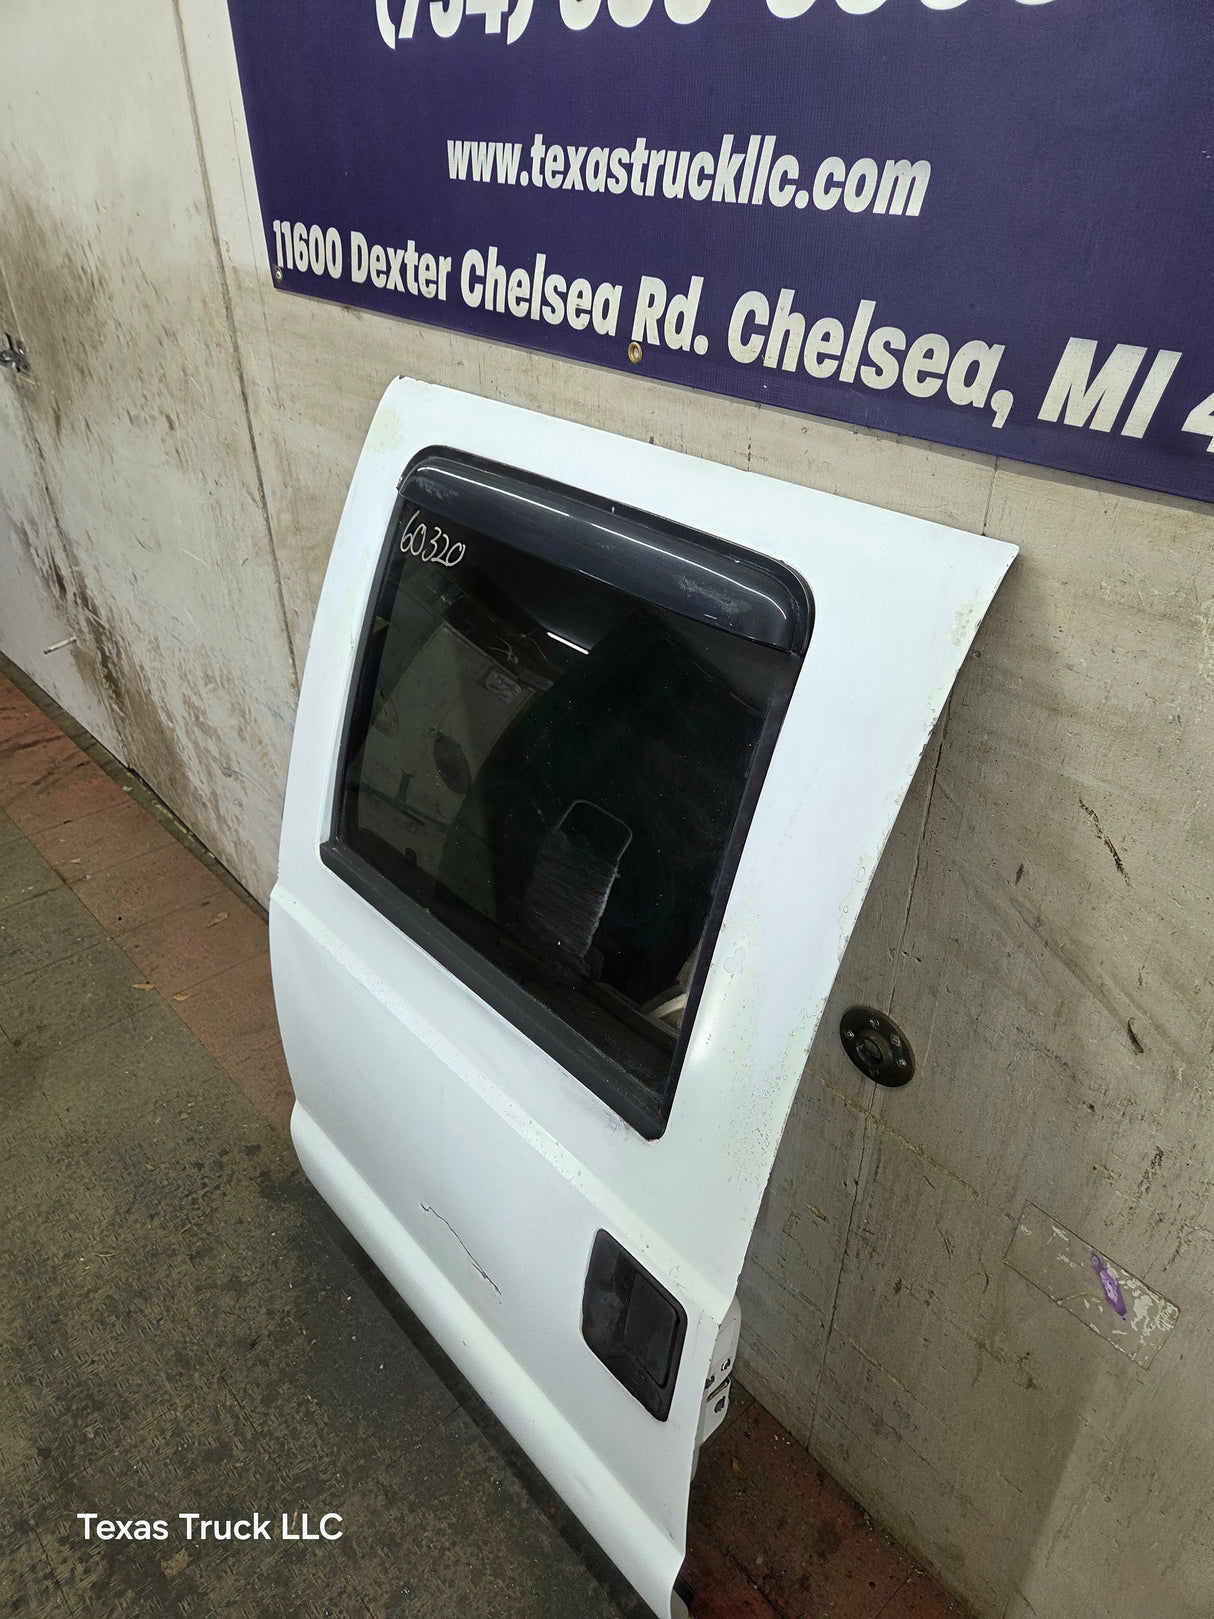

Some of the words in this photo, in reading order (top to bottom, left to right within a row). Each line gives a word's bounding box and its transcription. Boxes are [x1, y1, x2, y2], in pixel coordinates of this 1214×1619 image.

[446, 133, 932, 217] www.texastruckllc.com
[272, 219, 343, 279] 11600
[350, 230, 452, 301] Dexter
[460, 245, 623, 337] Chelsea
[631, 275, 709, 356] Rd.
[727, 287, 1014, 429] Chelsea,
[1037, 336, 1183, 439] MI
[400, 510, 466, 567] 60320
